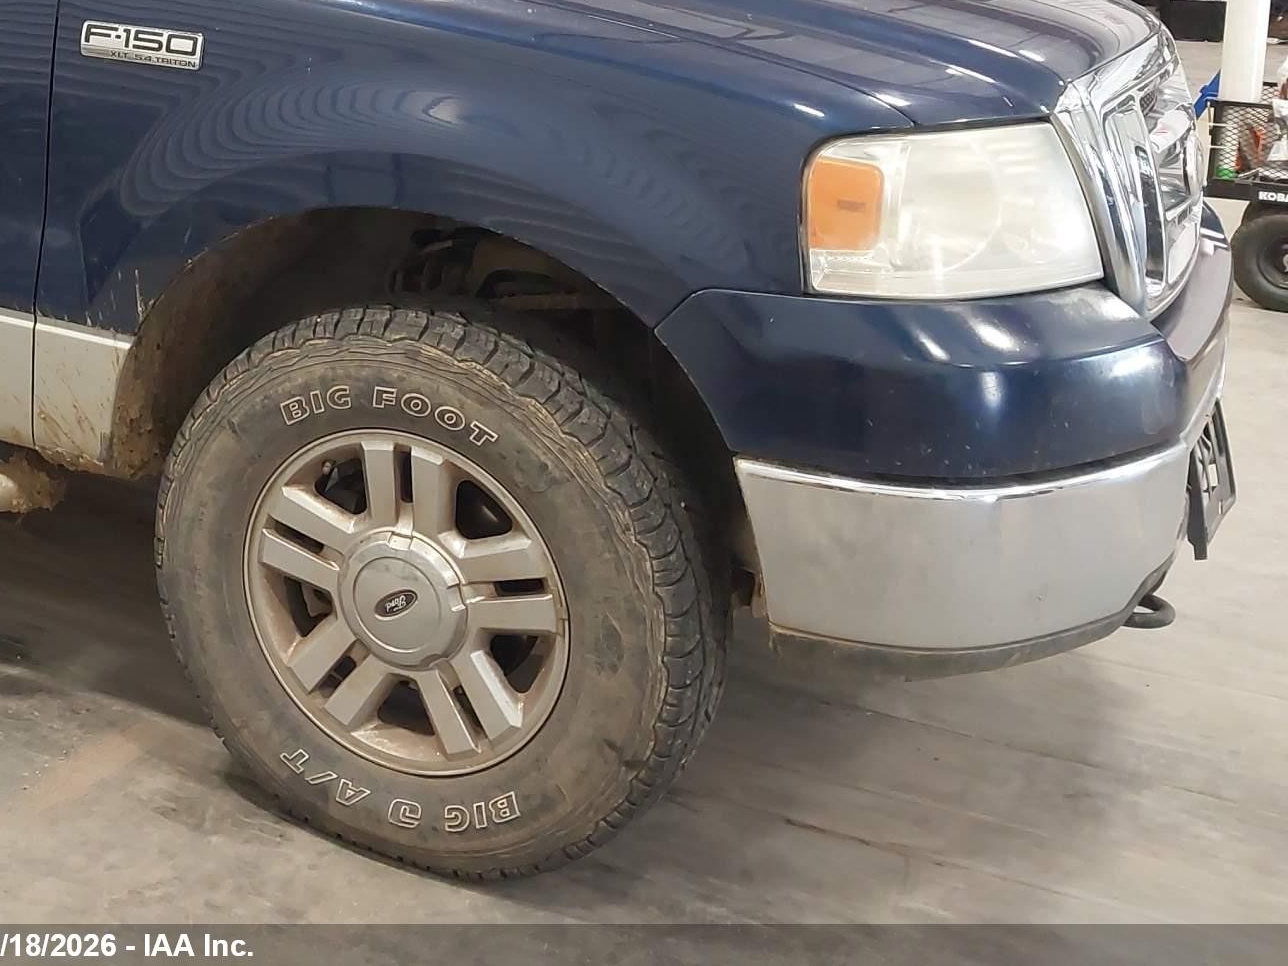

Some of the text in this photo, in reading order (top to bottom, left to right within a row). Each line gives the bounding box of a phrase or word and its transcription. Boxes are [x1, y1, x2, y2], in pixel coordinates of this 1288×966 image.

[110, 49, 129, 60] XLT
[155, 56, 197, 68] TRITON
[279, 385, 499, 447] BIG FOOT
[384, 594, 407, 613] Ford
[279, 748, 372, 807] A/T
[443, 791, 521, 832] BIG
